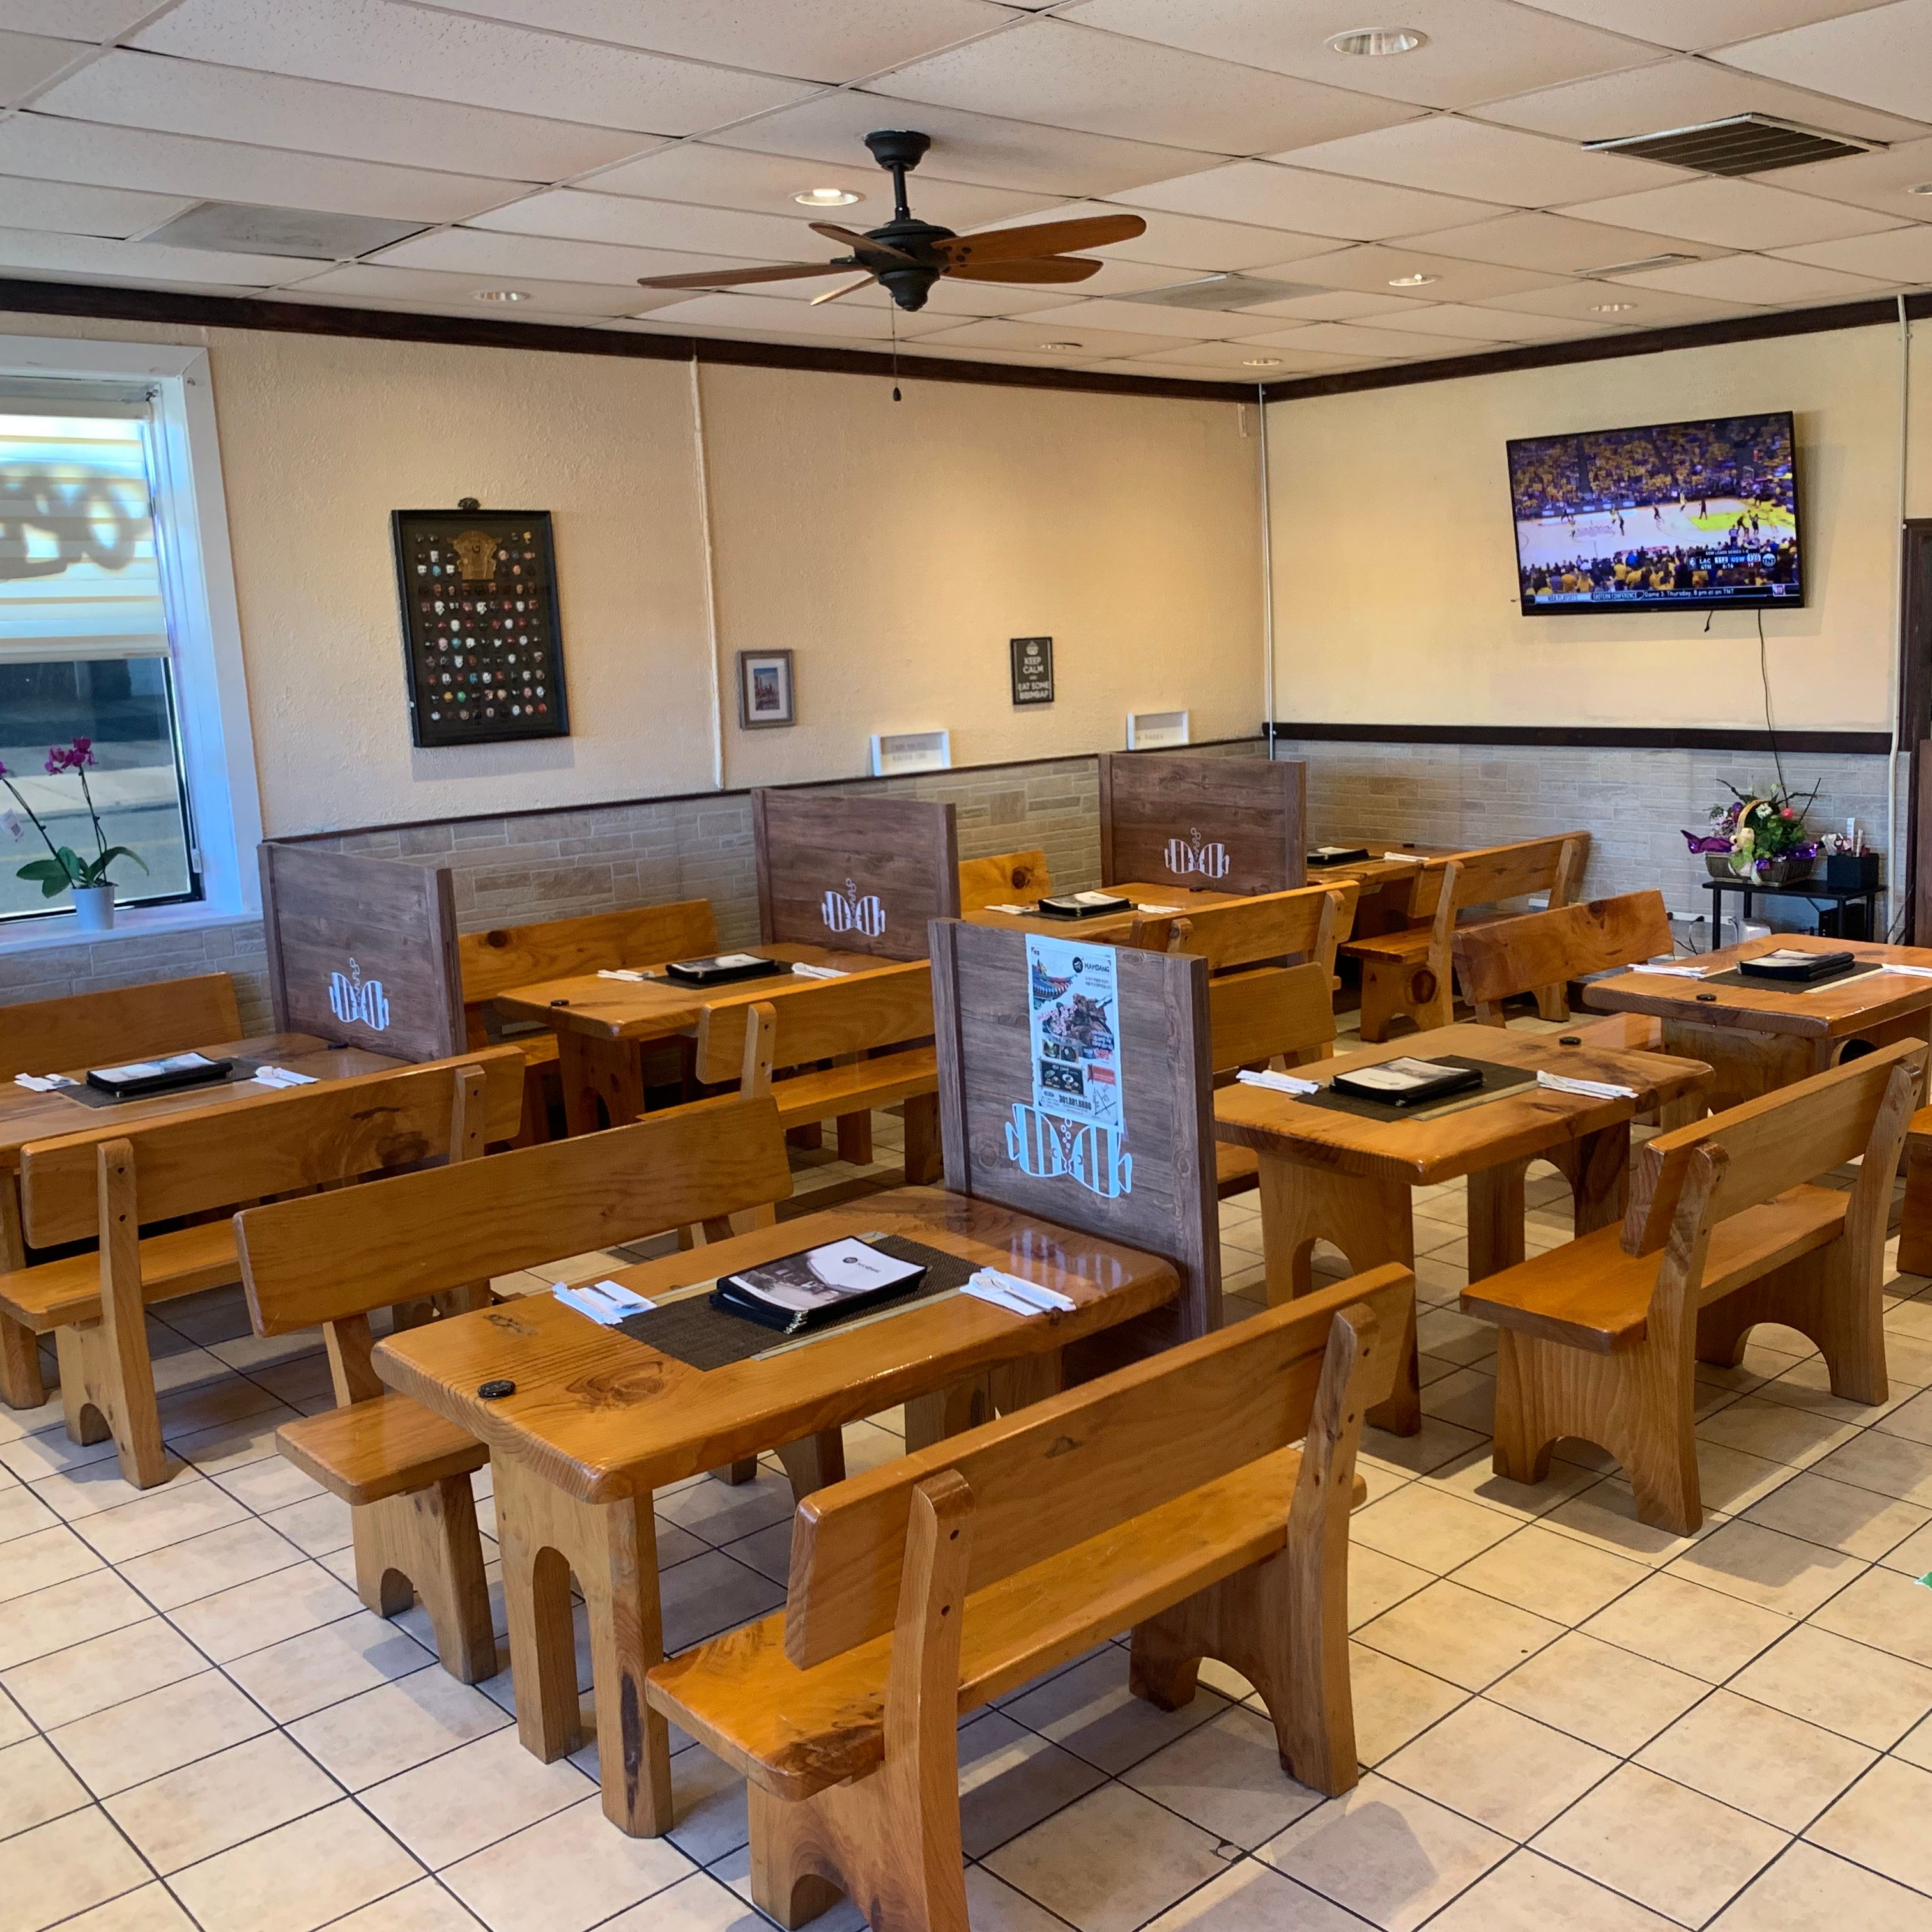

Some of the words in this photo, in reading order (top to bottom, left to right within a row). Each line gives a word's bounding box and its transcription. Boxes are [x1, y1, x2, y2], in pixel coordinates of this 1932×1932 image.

[1024, 657, 1041, 665] KEEP
[1023, 665, 1043, 674] CALM
[1018, 682, 1029, 691] EAT
[1031, 682, 1048, 690] SOME
[1145, 733, 1163, 741] happy
